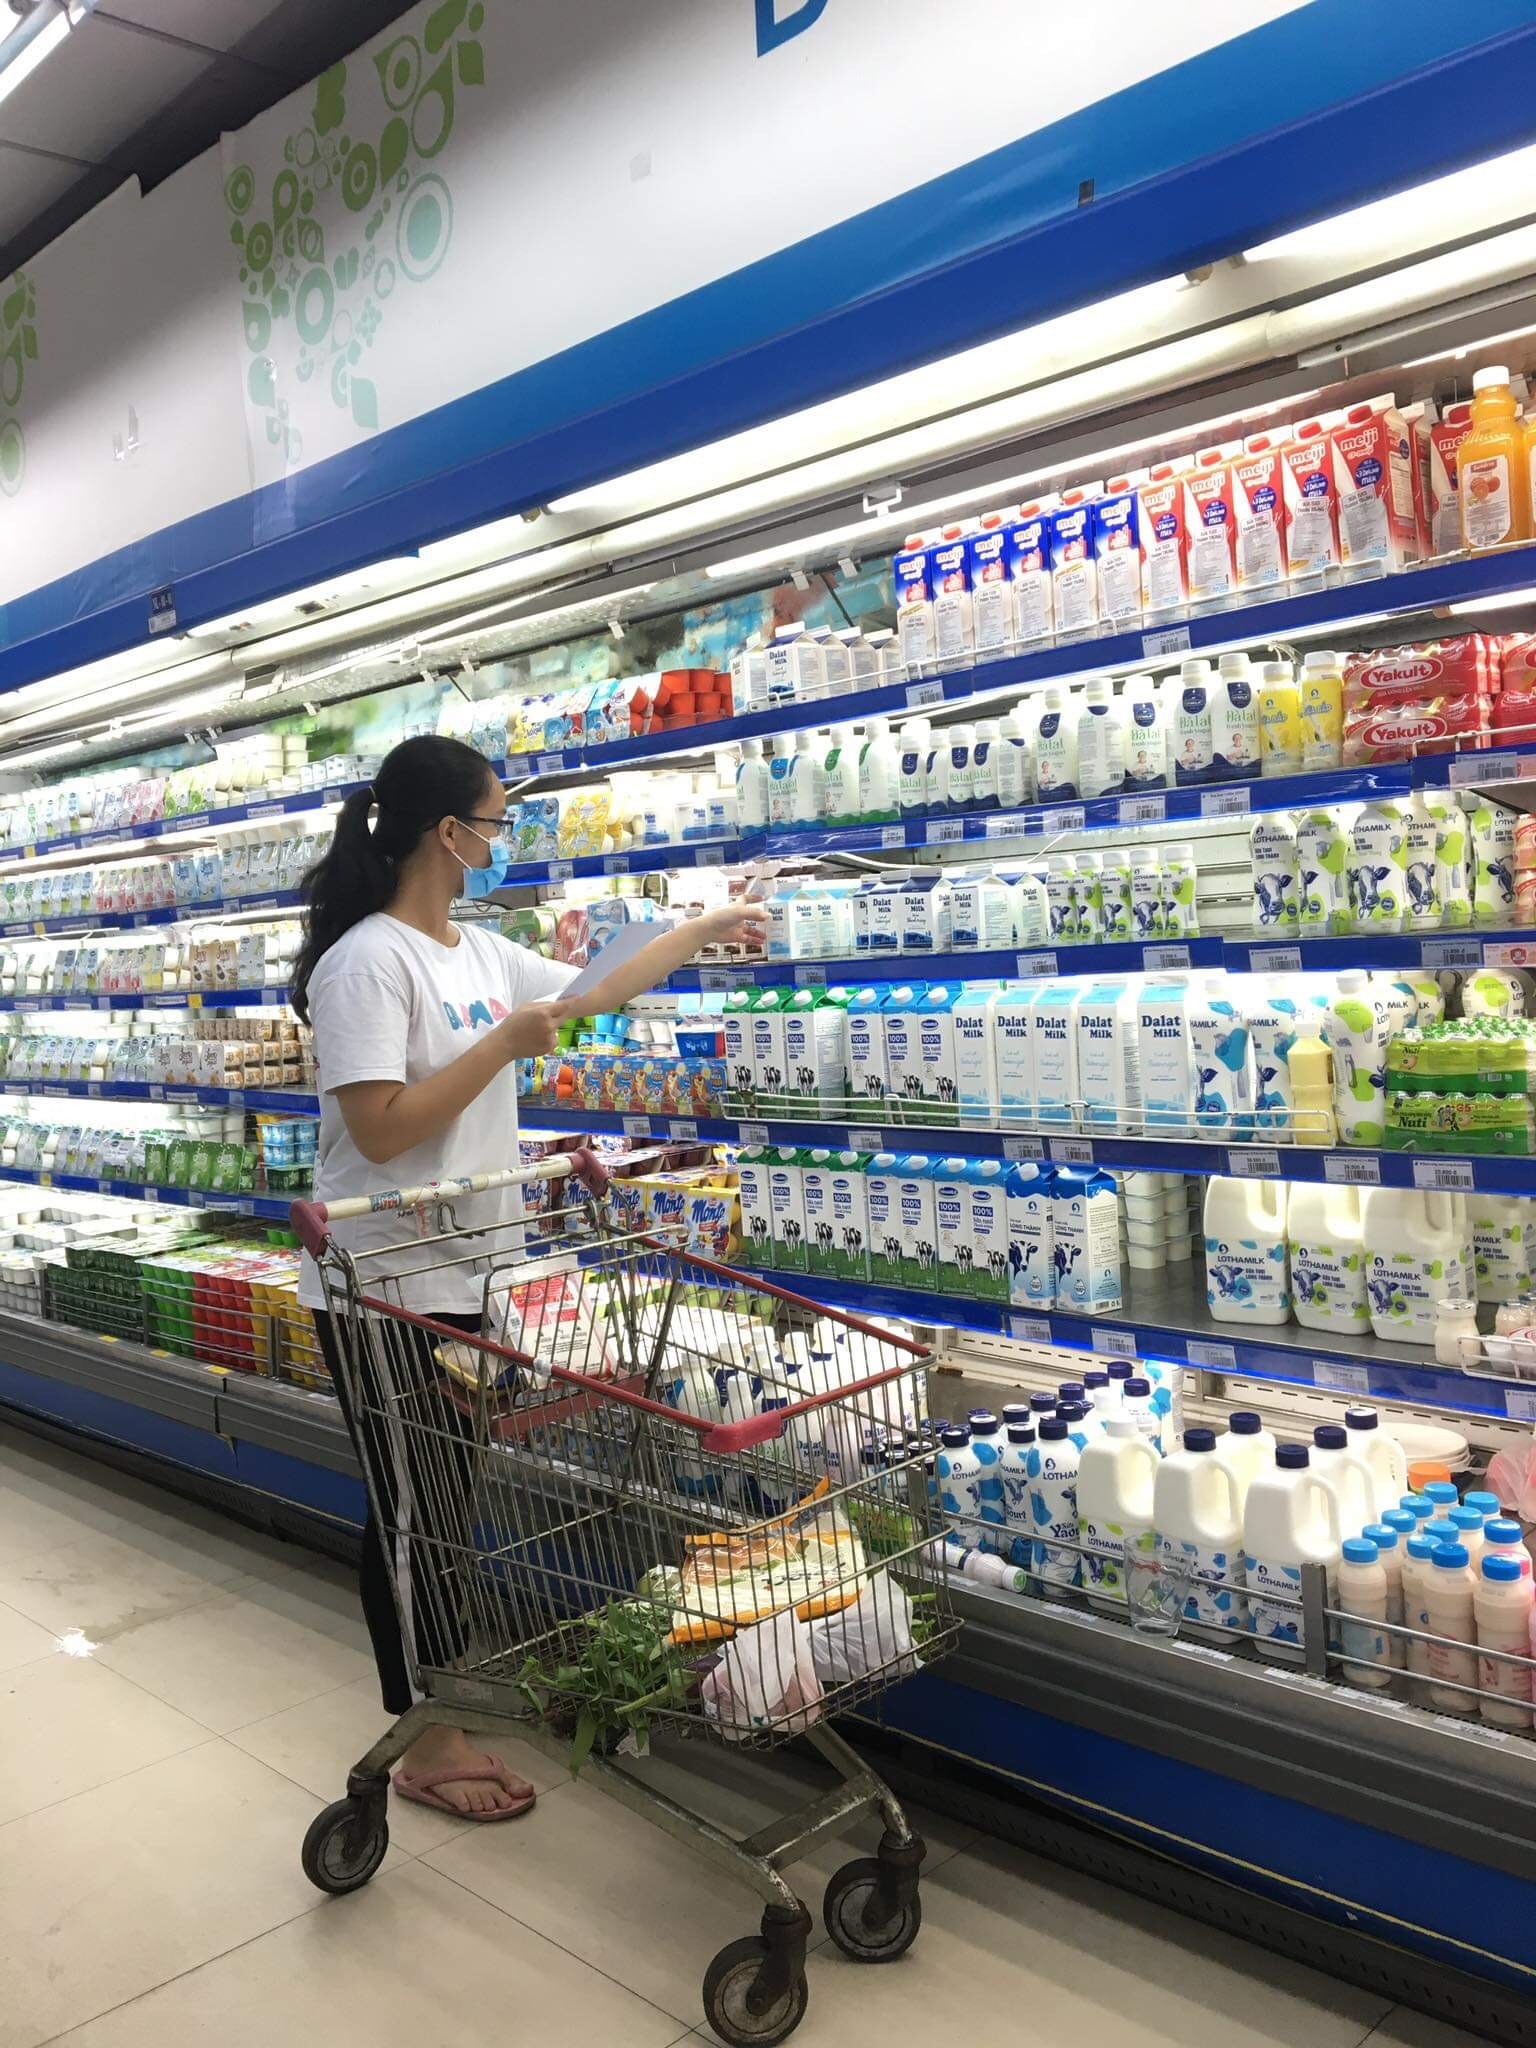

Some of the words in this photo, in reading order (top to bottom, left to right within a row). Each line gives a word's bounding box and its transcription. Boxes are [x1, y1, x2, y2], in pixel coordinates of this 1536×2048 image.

[1341, 428, 1379, 450] meiji
[1289, 442, 1326, 465] meiji
[1372, 664, 1429, 684] Yakult
[1375, 722, 1434, 742] Yakult
[873, 898, 892, 907] Dalat
[904, 896, 925, 906] Dalat
[954, 893, 972, 902] Dalat
[910, 905, 925, 913] Milk
[955, 1017, 984, 1029] Dalat
[997, 1015, 1028, 1028] Dalat
[1035, 1016, 1067, 1029] Dalat
[1081, 1015, 1113, 1028] Dalat
[1141, 1014, 1182, 1028] Dalat
[963, 1029, 984, 1039] Milk
[1005, 1028, 1028, 1038] Milk
[1044, 1029, 1067, 1040] Milk
[1089, 1028, 1113, 1039] Milk
[1152, 1028, 1182, 1039] Milk
[1399, 1116, 1427, 1128] Nuti
[807, 1190, 822, 1198] 100%
[835, 1194, 851, 1202] 100%
[653, 1190, 686, 1215] Monte
[871, 1196, 888, 1204] 100%
[902, 1199, 920, 1208] 100%
[691, 1199, 726, 1223] Monte
[939, 1202, 960, 1211] 100%
[973, 1207, 993, 1216] 100%
[1217, 1255, 1265, 1265] LOTHAMILK
[1298, 1259, 1340, 1272] LOTHAMILK
[1373, 1268, 1421, 1281] LOTHAMILK
[1087, 1537, 1123, 1551] LOTHAMIL
[1257, 1575, 1301, 1592] LOTHAMILK
